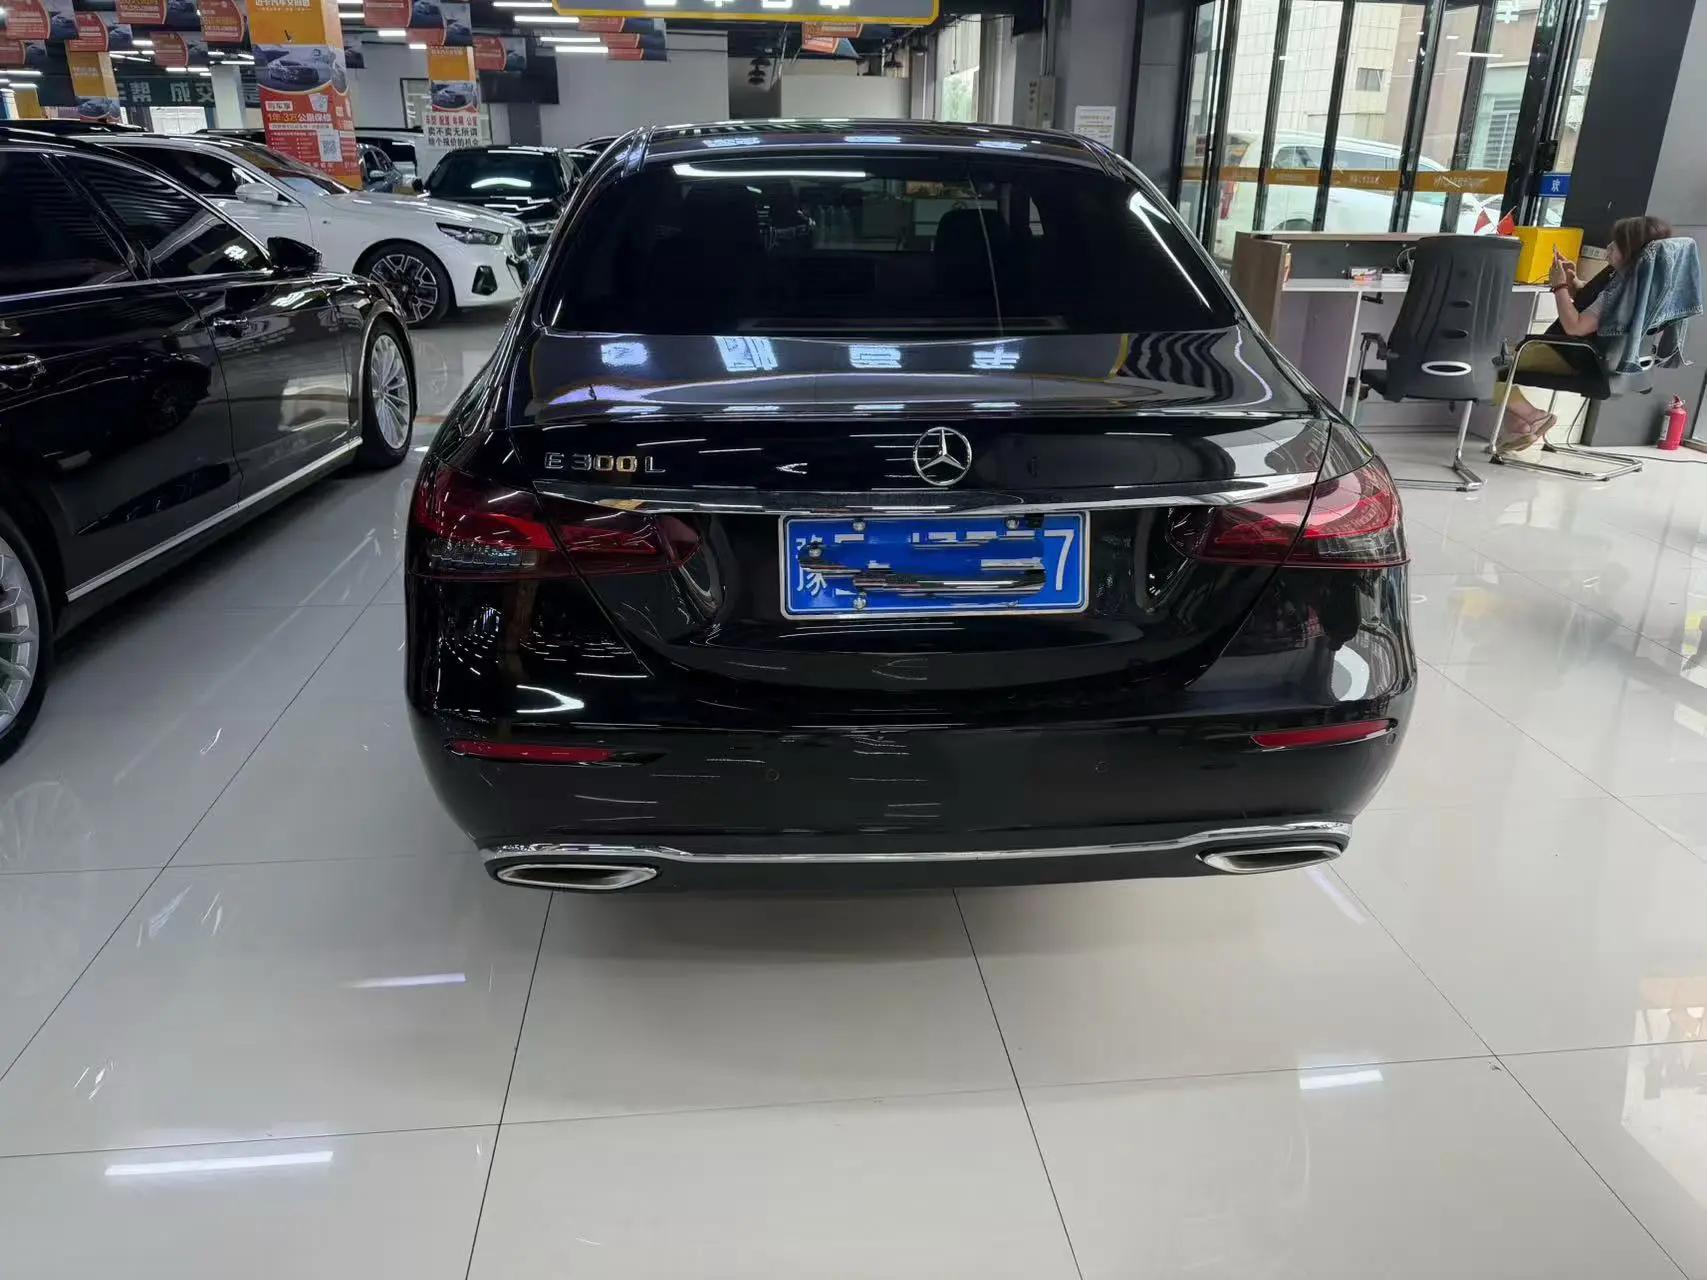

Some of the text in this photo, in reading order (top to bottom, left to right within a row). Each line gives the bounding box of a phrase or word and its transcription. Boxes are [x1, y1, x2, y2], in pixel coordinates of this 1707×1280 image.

[543, 452, 667, 473] E 300 L
